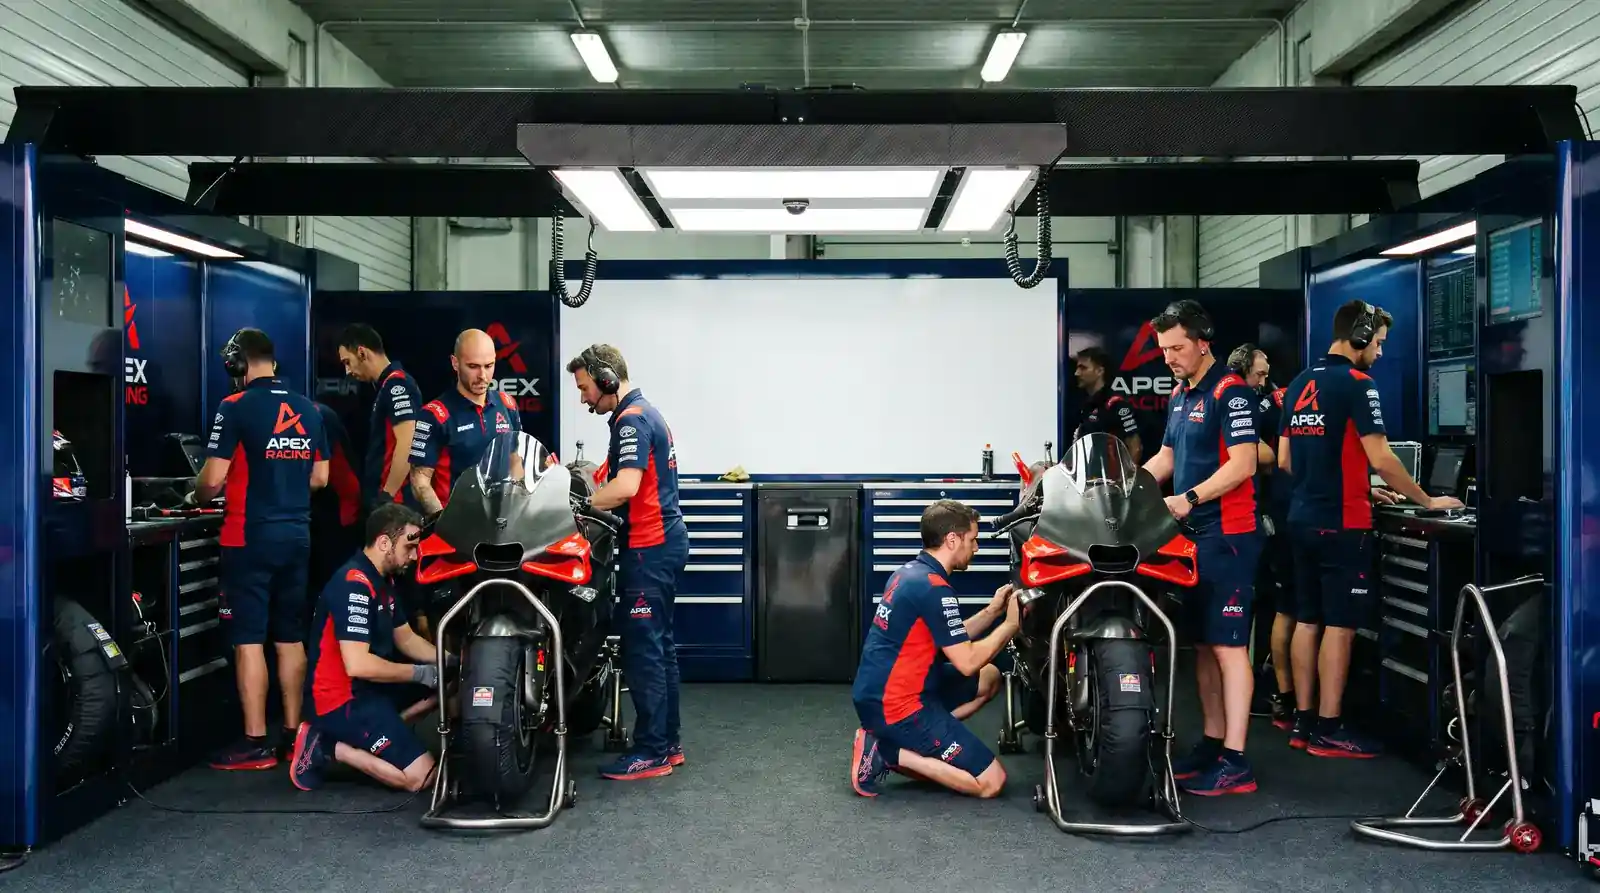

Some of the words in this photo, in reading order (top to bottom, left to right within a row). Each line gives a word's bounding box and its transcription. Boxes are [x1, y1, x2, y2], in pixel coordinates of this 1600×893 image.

[125, 357, 148, 384] EX
[487, 378, 540, 396] PEX
[1110, 376, 1183, 395] APE
[125, 386, 148, 405] ING
[1290, 414, 1325, 426] APEX
[1290, 426, 1325, 436] RACING
[265, 437, 311, 450] APEX
[265, 450, 310, 460] RACING
[1222, 605, 1244, 613] APEX
